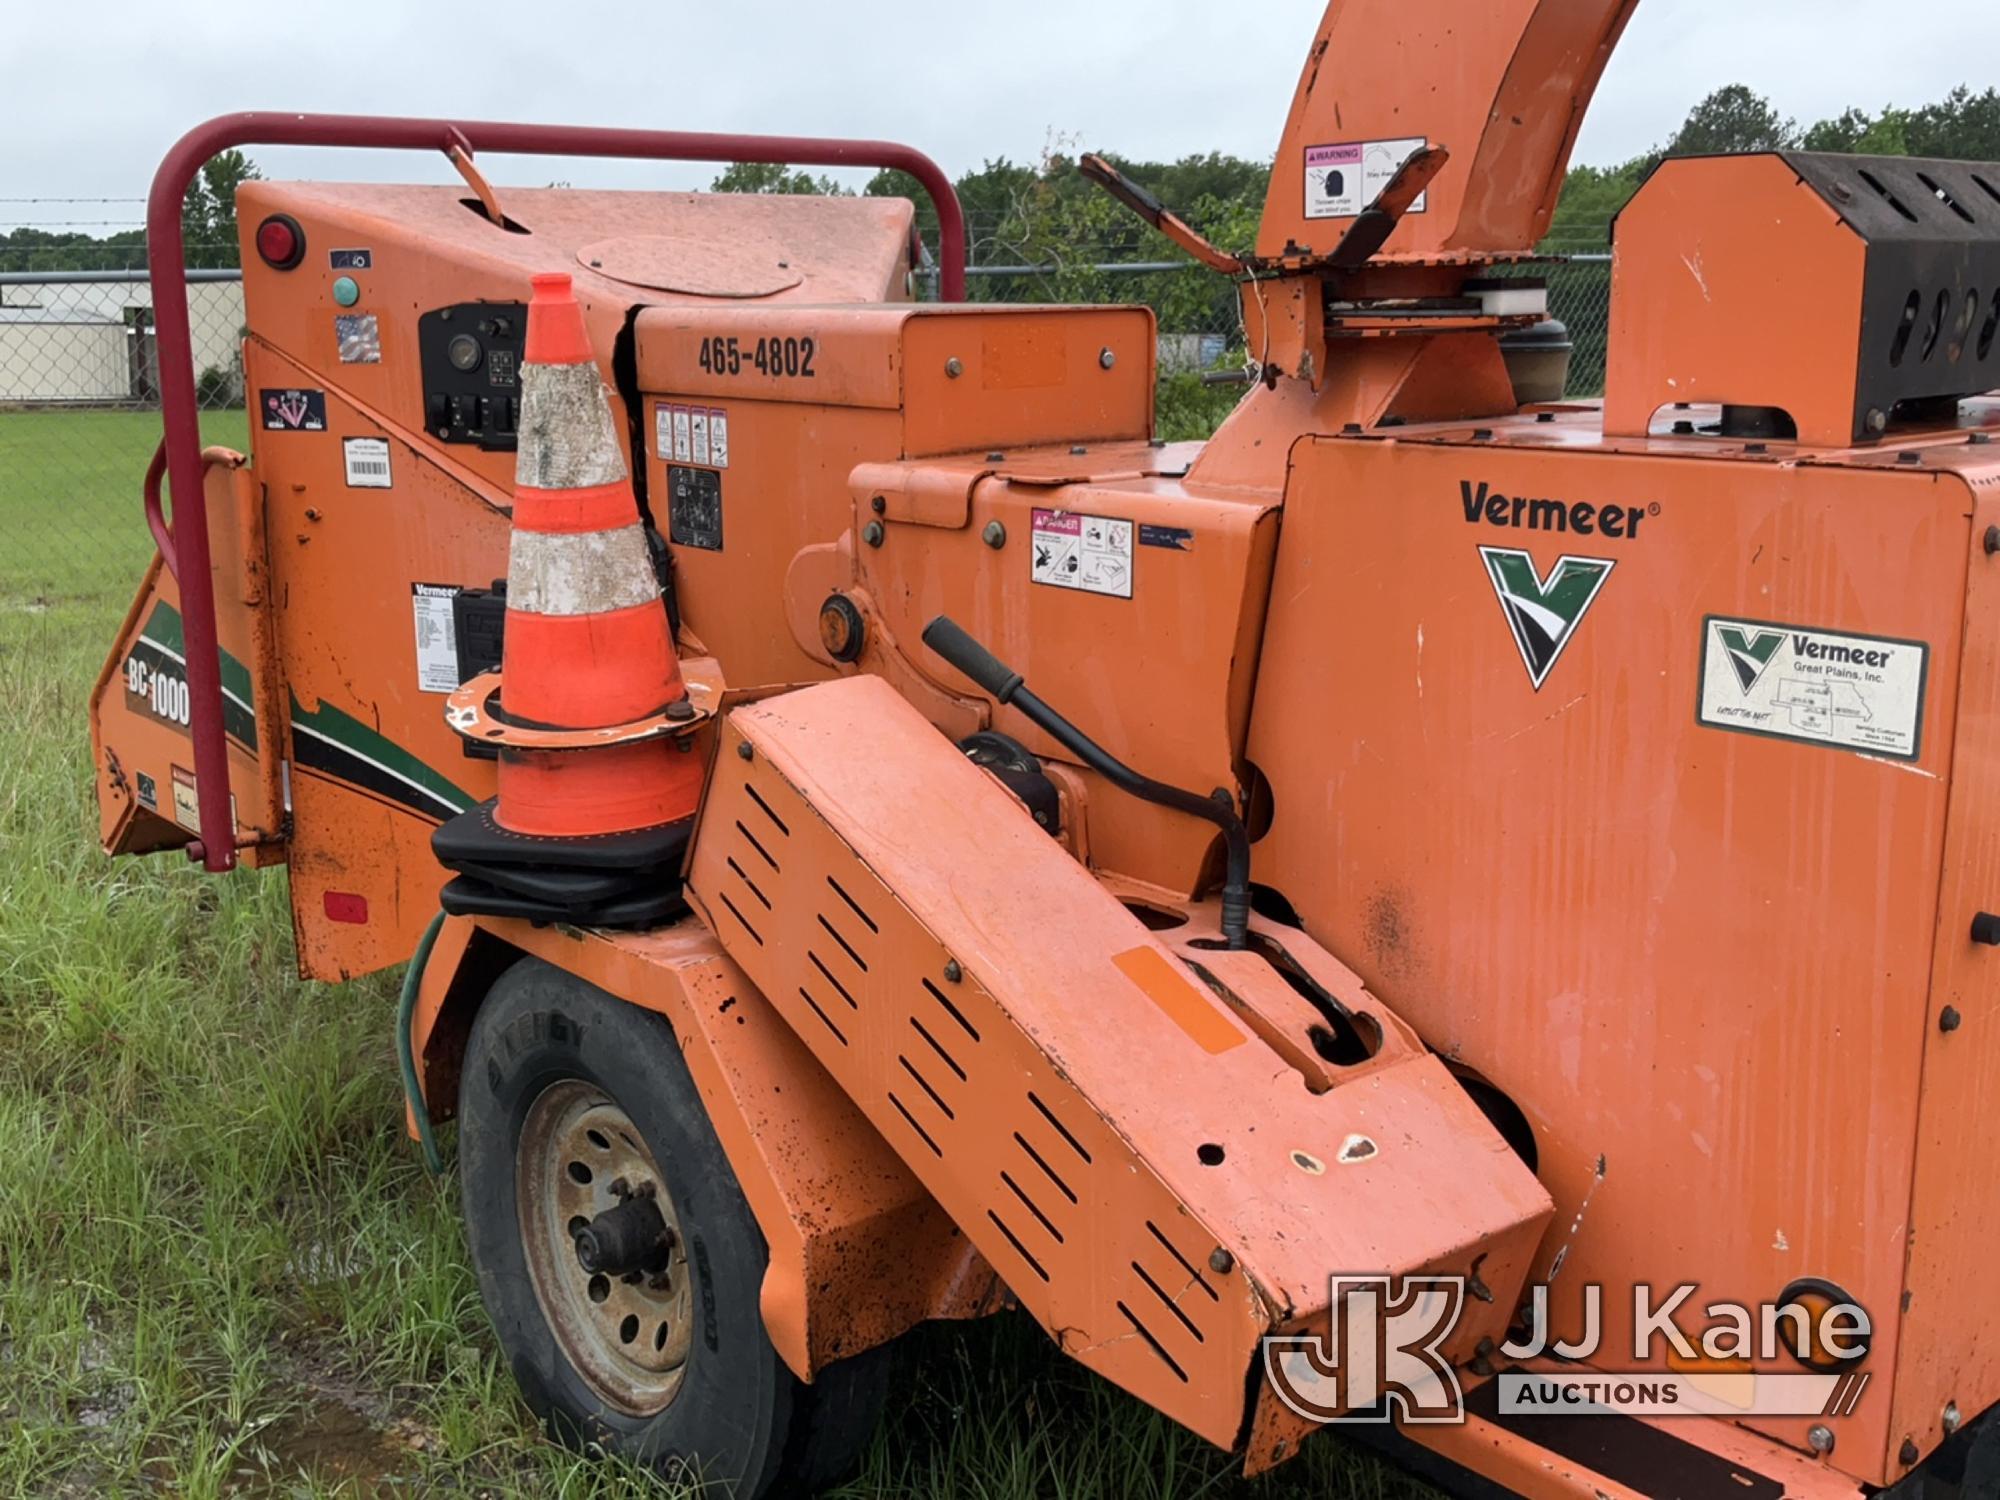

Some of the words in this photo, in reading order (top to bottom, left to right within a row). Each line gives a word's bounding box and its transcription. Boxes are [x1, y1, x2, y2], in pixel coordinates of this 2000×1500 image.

[1315, 149, 1359, 161] WARNING
[699, 336, 815, 377] 465-4802
[1794, 661, 1823, 674] Great
[1826, 665, 1862, 681] Plains,
[1865, 671, 1885, 684] Inc.
